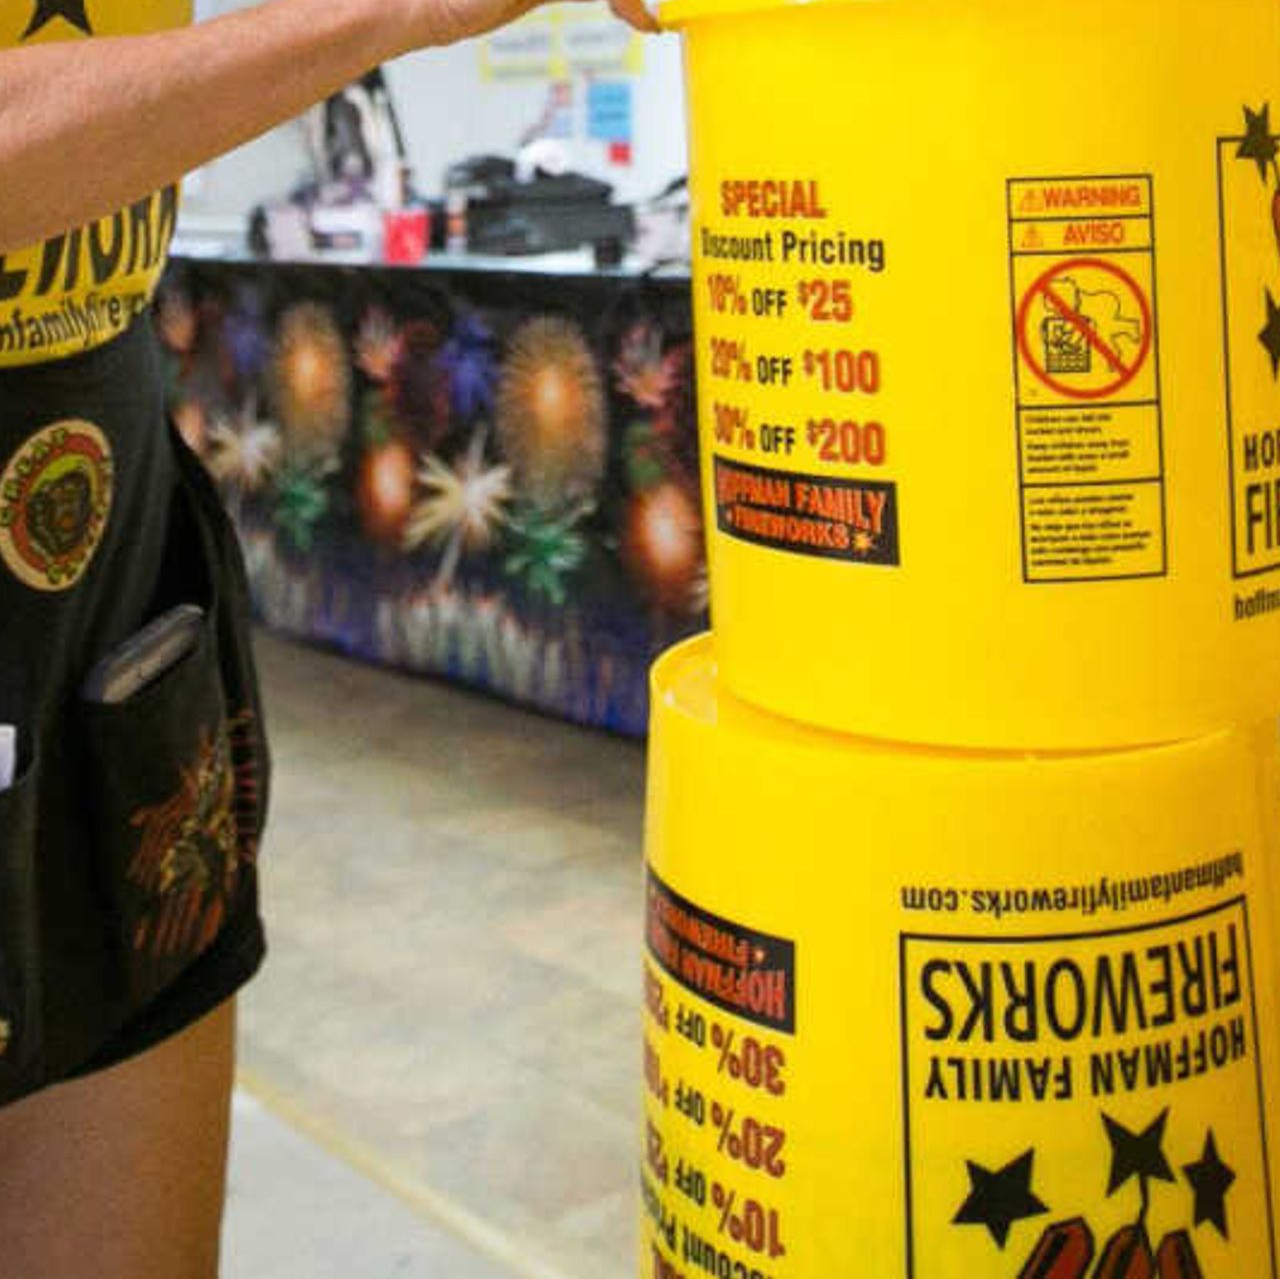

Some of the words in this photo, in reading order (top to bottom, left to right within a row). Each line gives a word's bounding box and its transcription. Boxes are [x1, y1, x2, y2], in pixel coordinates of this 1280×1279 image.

[721, 180, 827, 218] SPECIAL
[1044, 185, 1141, 208] WARNING
[781, 231, 884, 272] Pricing
[1063, 221, 1124, 246] AVISO
[752, 288, 787, 316] OFF
[799, 279, 853, 322] $25
[757, 355, 792, 386] OFF
[803, 348, 881, 394] $100
[760, 423, 795, 455] OFF
[806, 417, 886, 466] $200
[795, 482, 886, 532] FAMILY
[900, 851, 1243, 919] hoffmanfamilyfireworks.com
[682, 950, 786, 1019] HOFFMAN
[919, 922, 1241, 1044] FIREWORKS
[674, 1002, 706, 1048] OFF
[710, 1023, 786, 1097] 30%
[923, 1052, 1073, 1101] FAMILY
[1089, 1015, 1246, 1096] HOFFMAN
[674, 1081, 706, 1126] OFF
[710, 1101, 787, 1179] 20%
[674, 1157, 706, 1207] OFF
[710, 1181, 786, 1260] 10%
